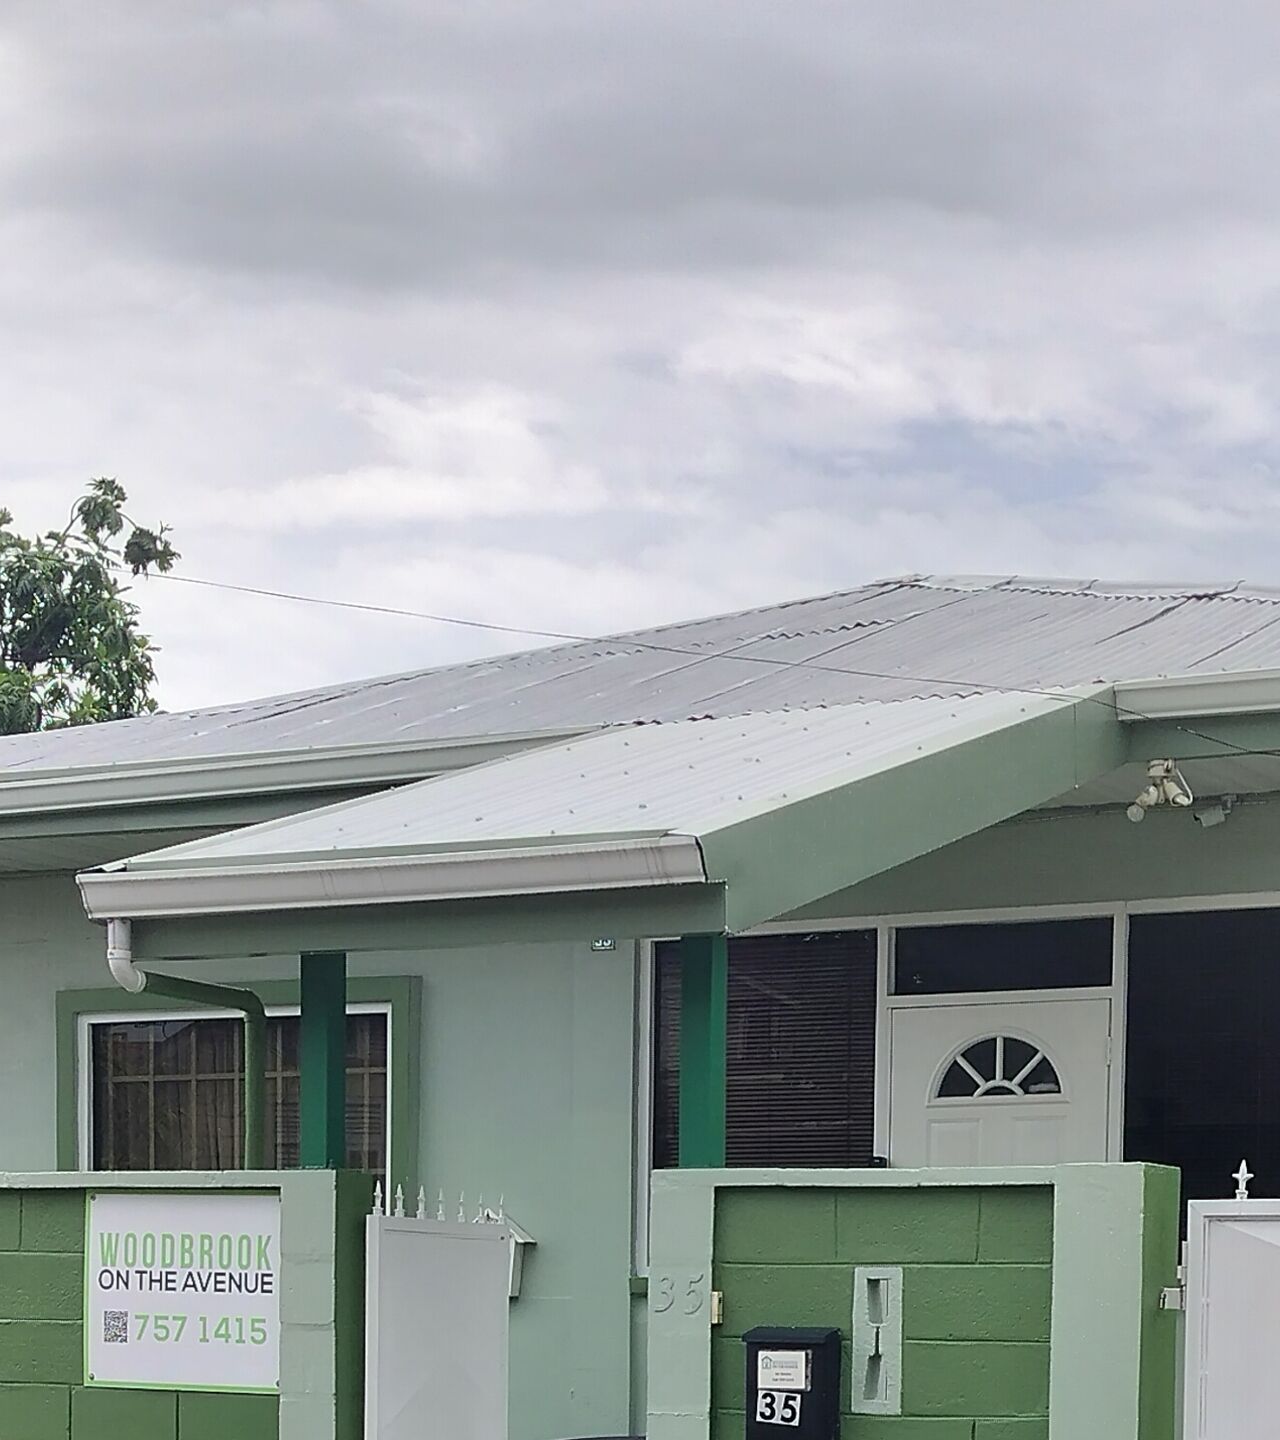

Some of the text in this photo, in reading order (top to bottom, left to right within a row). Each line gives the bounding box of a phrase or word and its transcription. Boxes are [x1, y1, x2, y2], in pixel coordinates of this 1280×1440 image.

[99, 1233, 273, 1270] WOODBROOK
[98, 1269, 273, 1293] ON THE AVENUE
[654, 1273, 704, 1315] 35
[134, 1315, 267, 1344] 757 1415
[759, 1392, 797, 1423] 35
